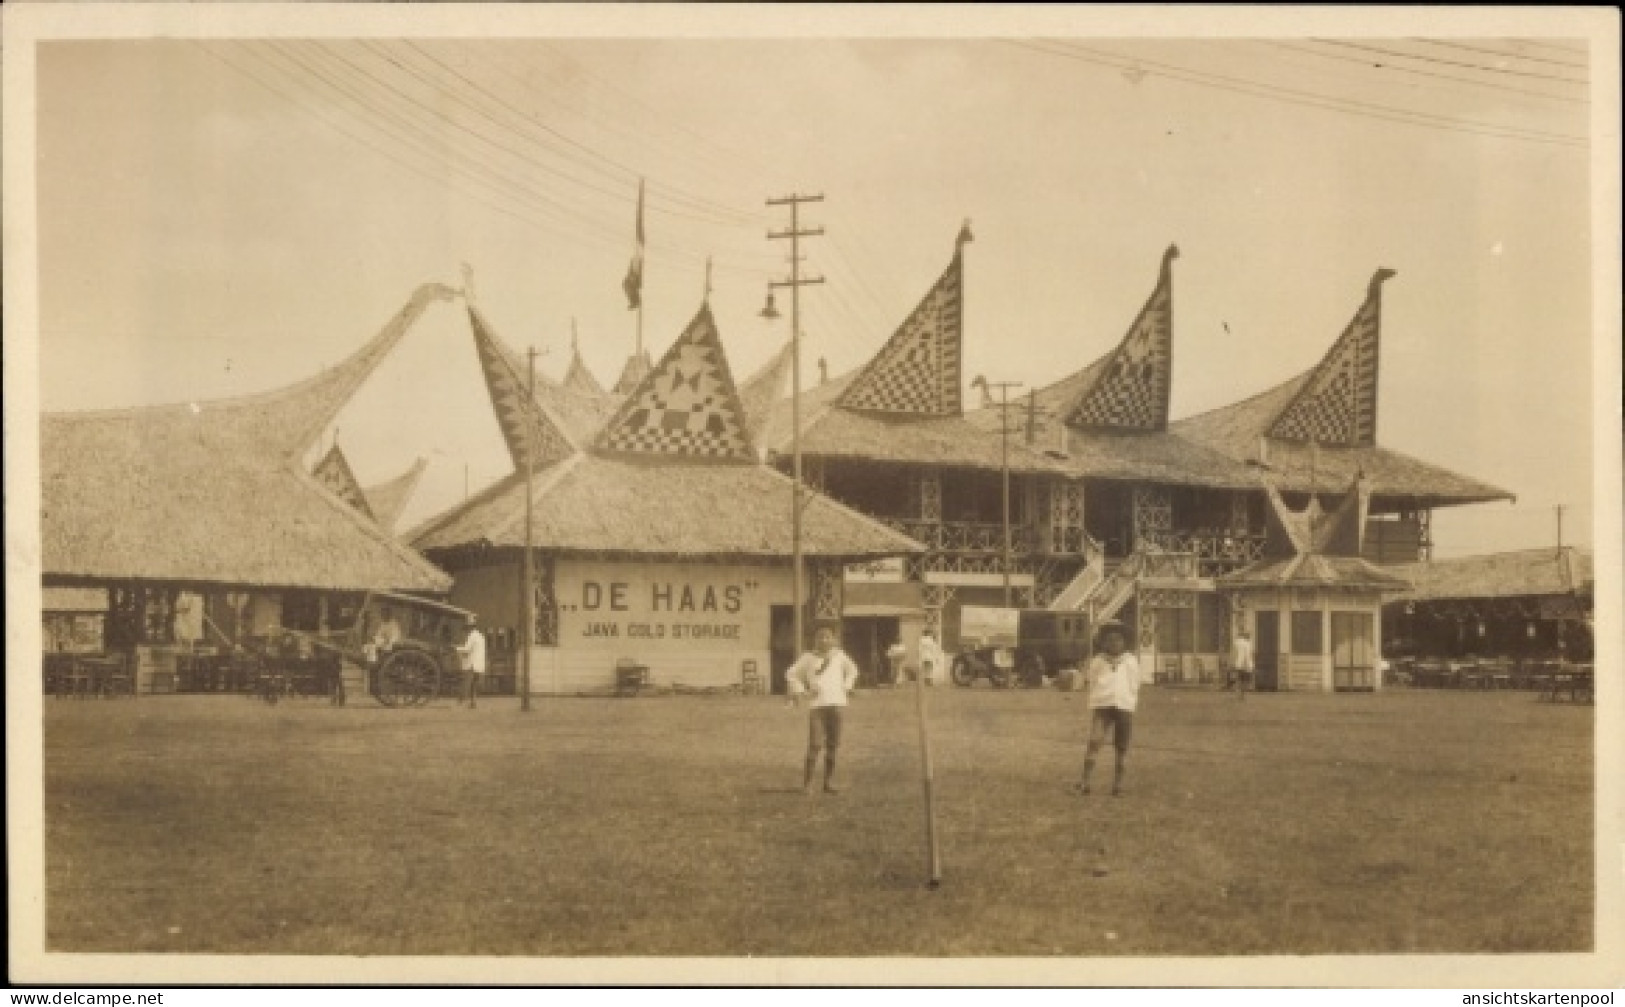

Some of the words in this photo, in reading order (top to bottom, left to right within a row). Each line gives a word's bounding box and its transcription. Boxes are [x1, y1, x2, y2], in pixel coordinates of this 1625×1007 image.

[582, 622, 619, 638] JAVA
[627, 623, 665, 639] COLD
[671, 623, 742, 640] STORAGE
